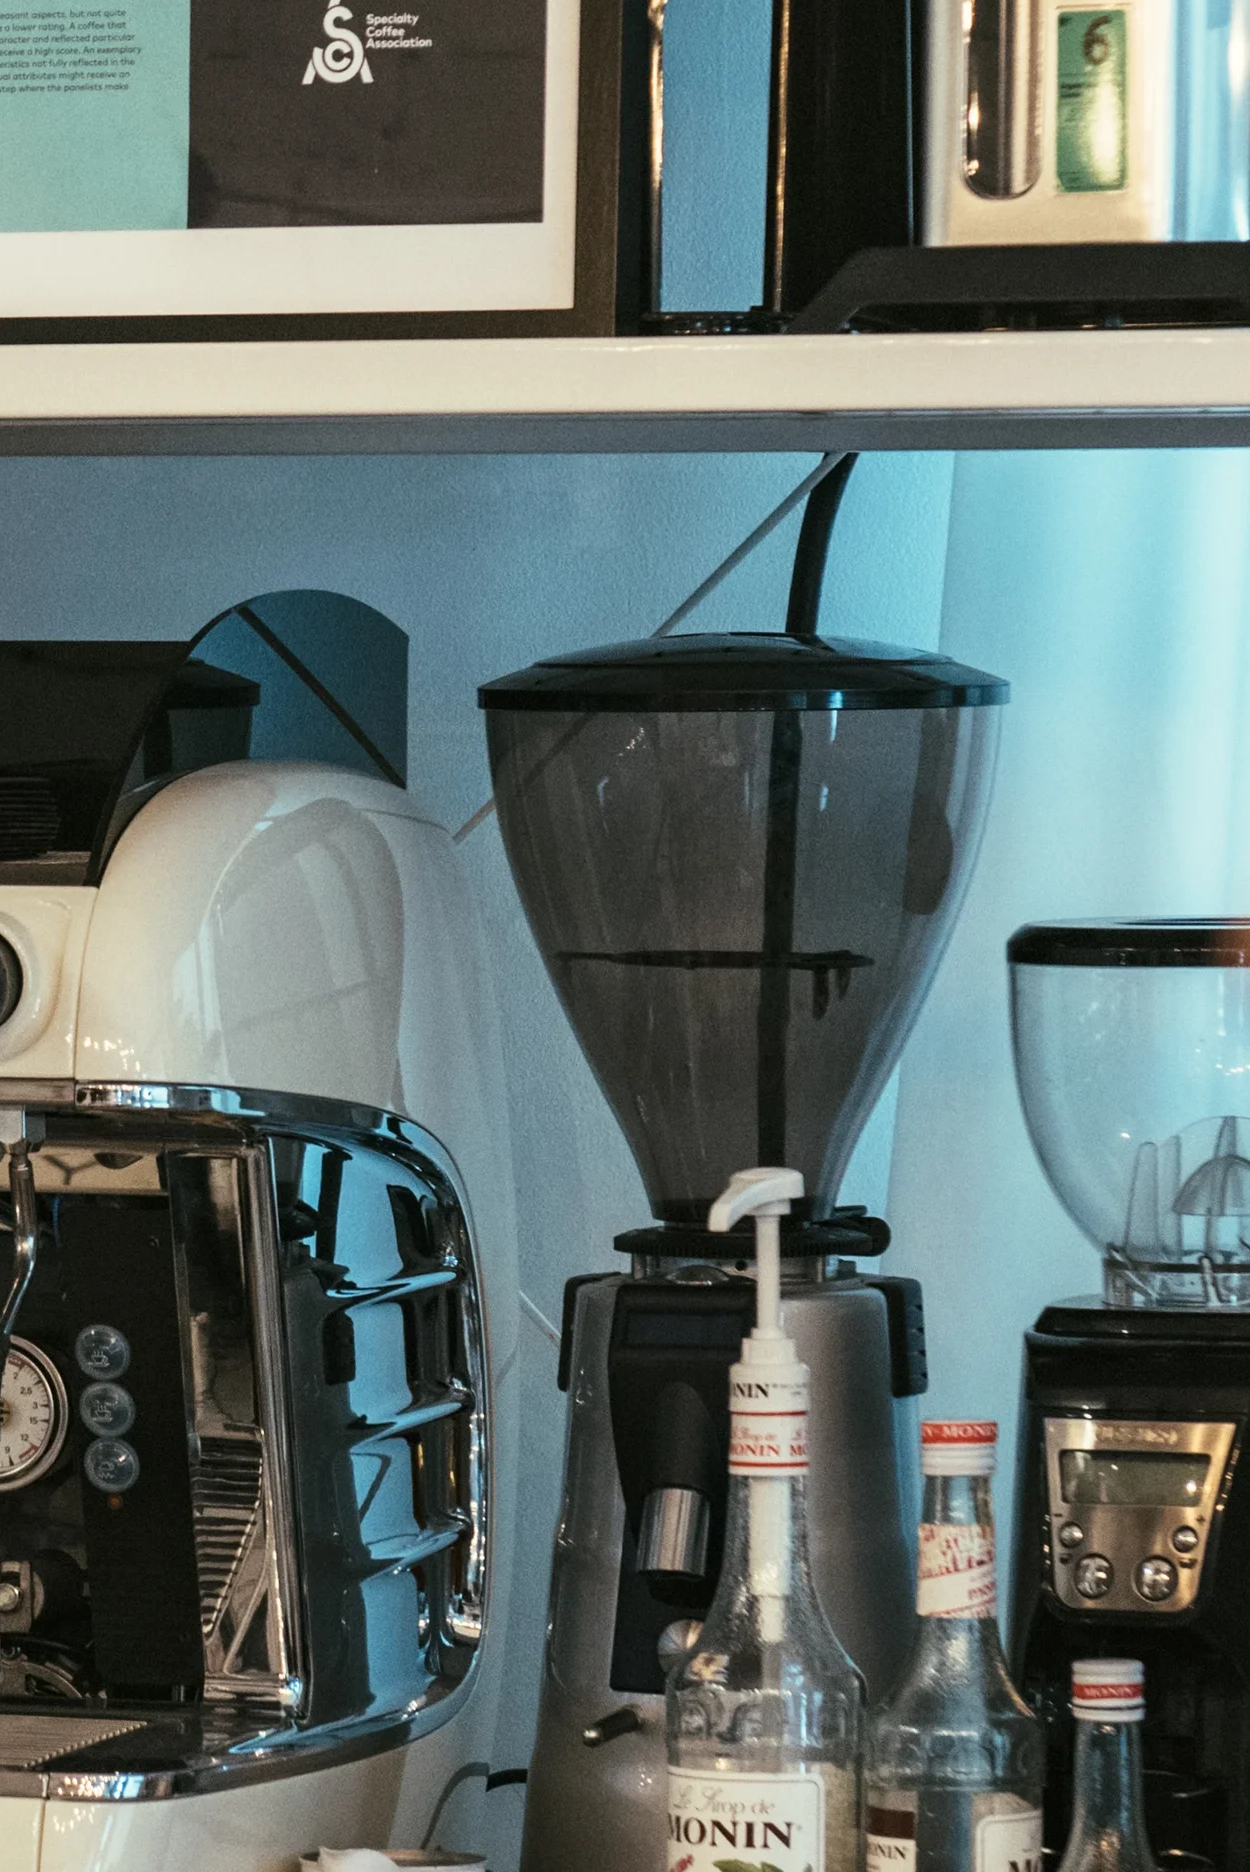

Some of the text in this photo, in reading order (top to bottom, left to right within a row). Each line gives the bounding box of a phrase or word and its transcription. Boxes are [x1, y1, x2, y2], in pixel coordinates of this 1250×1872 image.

[366, 12, 419, 26] Specialty
[366, 26, 405, 37] Coffee
[366, 37, 432, 48] Association
[1083, 15, 1112, 66] 6
[732, 1382, 770, 1398] NIN
[32, 1401, 38, 1409] 3
[29, 1416, 38, 1425] 15
[21, 1434, 29, 1442] 12
[667, 1812, 793, 1850] MONIN
[868, 1841, 906, 1860] ONIN
